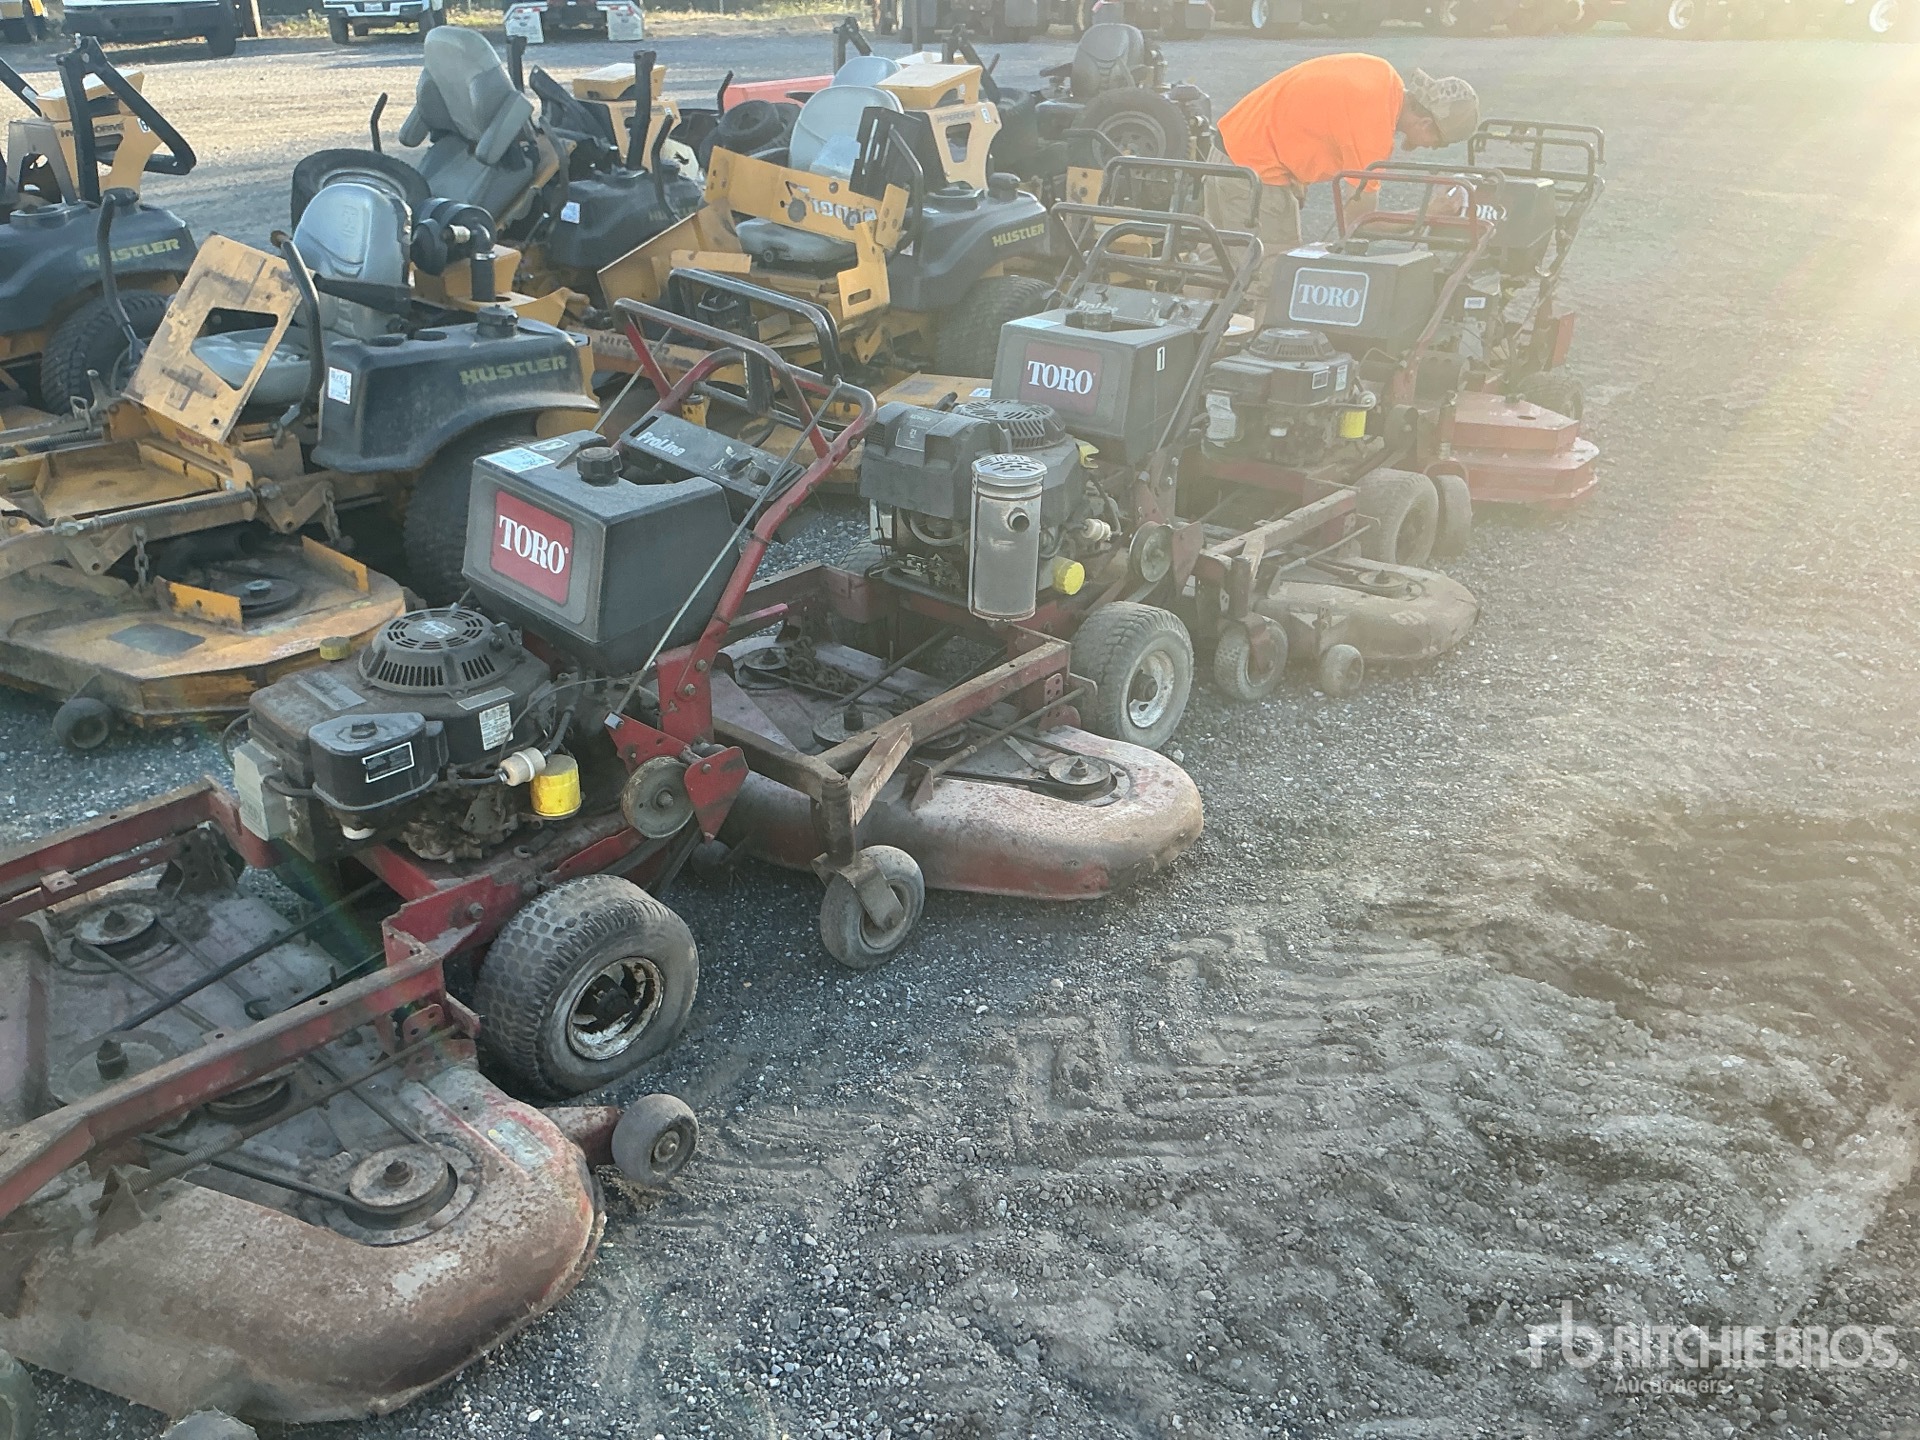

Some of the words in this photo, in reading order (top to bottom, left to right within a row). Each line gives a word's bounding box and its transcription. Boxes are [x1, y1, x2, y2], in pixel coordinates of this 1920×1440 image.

[60, 122, 125, 138] HYDRIVE
[1461, 202, 1507, 220] ORO
[992, 223, 1045, 247] HUSTLER
[1298, 283, 1360, 309] TORO
[459, 354, 567, 386] HUSTLER
[1027, 360, 1093, 395] TORO
[637, 431, 686, 457] ProLine
[499, 514, 566, 575] TORO
